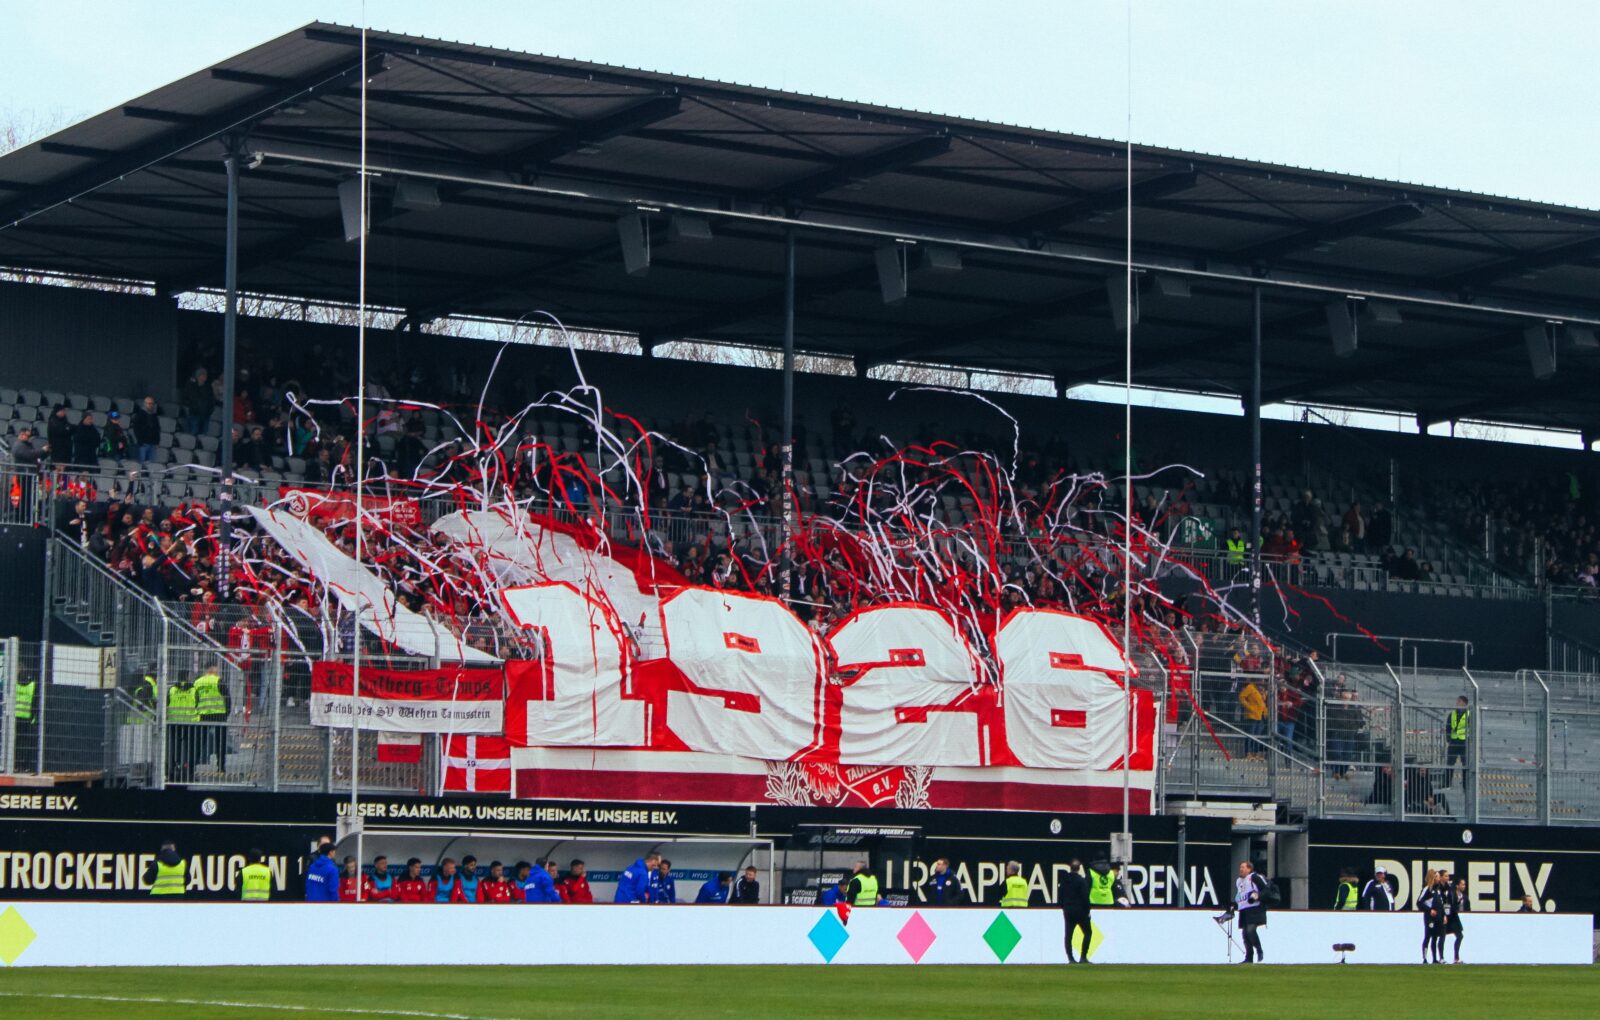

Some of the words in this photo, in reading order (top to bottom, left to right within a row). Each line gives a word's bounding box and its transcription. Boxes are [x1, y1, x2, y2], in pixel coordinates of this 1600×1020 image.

[503, 581, 1138, 770] 1926
[398, 706, 438, 719] Wehen
[46, 796, 78, 810] ELV.
[389, 804, 473, 819] SAARLAND.
[476, 806, 533, 820] UNSERE
[536, 808, 592, 823] HEIMAT.
[594, 810, 648, 824] UNSERE
[651, 811, 679, 825] ELV.
[186, 854, 287, 892] AUGN
[1468, 861, 1556, 913] ELV.
